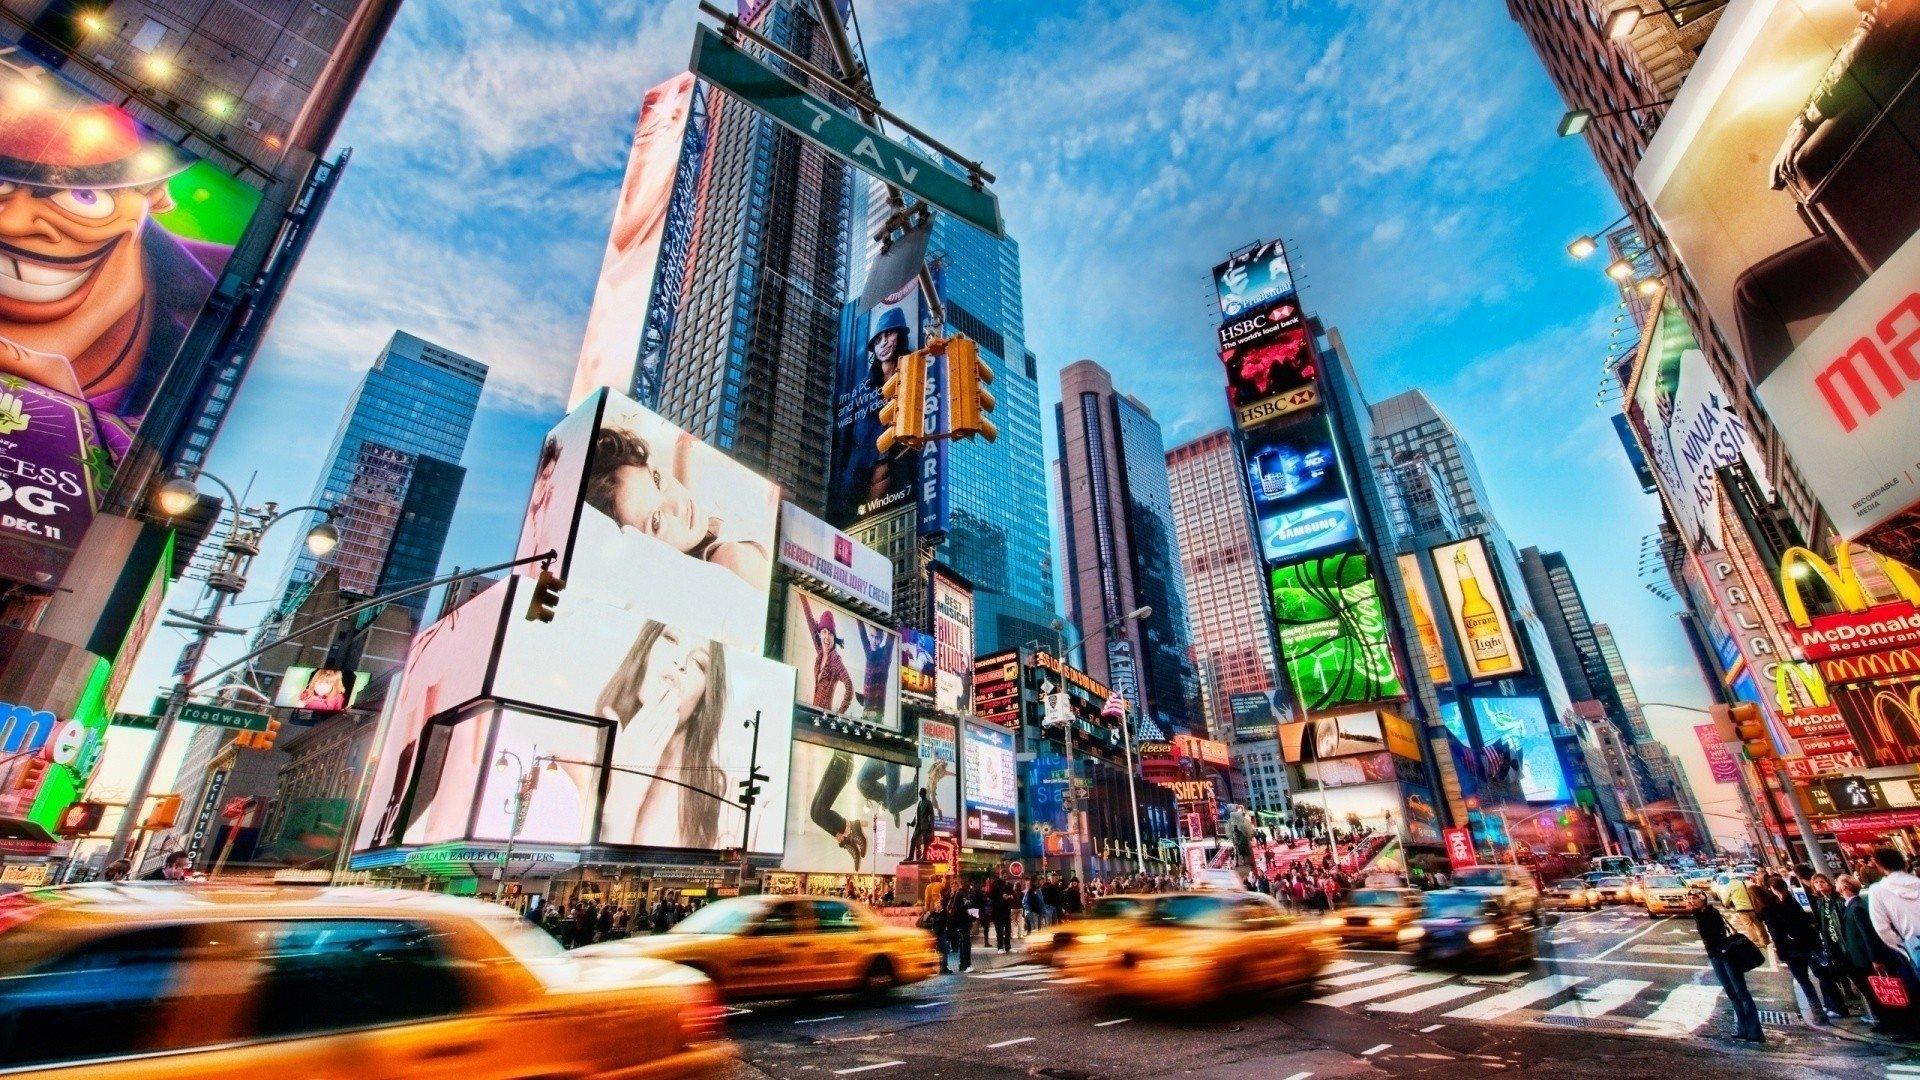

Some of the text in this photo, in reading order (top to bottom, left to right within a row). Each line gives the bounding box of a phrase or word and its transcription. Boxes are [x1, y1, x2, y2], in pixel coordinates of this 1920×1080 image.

[802, 98, 832, 133] 7
[1243, 280, 1292, 308] Prudential
[1220, 315, 1267, 342] HSBC
[1223, 317, 1299, 350] The world's local bank
[859, 379, 871, 393] PC
[838, 387, 883, 418] and Windo
[1241, 398, 1288, 423] HSBC
[838, 415, 853, 429] was
[855, 406, 869, 420] my
[922, 377, 939, 502] SQUARE
[1681, 402, 1719, 473] NINJA
[867, 485, 912, 512] Windows 7
[1852, 477, 1900, 510] RECORDABLE
[1857, 501, 1880, 517] MEDIA
[2, 515, 60, 540] DEC. 11
[1278, 517, 1337, 540] SAMSUNG
[783, 541, 816, 568] READY
[816, 556, 833, 578] FOR
[833, 564, 868, 595] HOLIDAY
[868, 584, 890, 607] CHEER
[937, 601, 970, 628] MUSICAL
[944, 593, 963, 611] BEST
[938, 616, 960, 651] BILLY
[1474, 638, 1502, 651] Light
[184, 708, 253, 727] roadway
[1804, 741, 1831, 750] OPEN
[1833, 739, 1846, 748] 24
[450, 851, 486, 861] EAGLE
[487, 851, 554, 862] OUTERS
